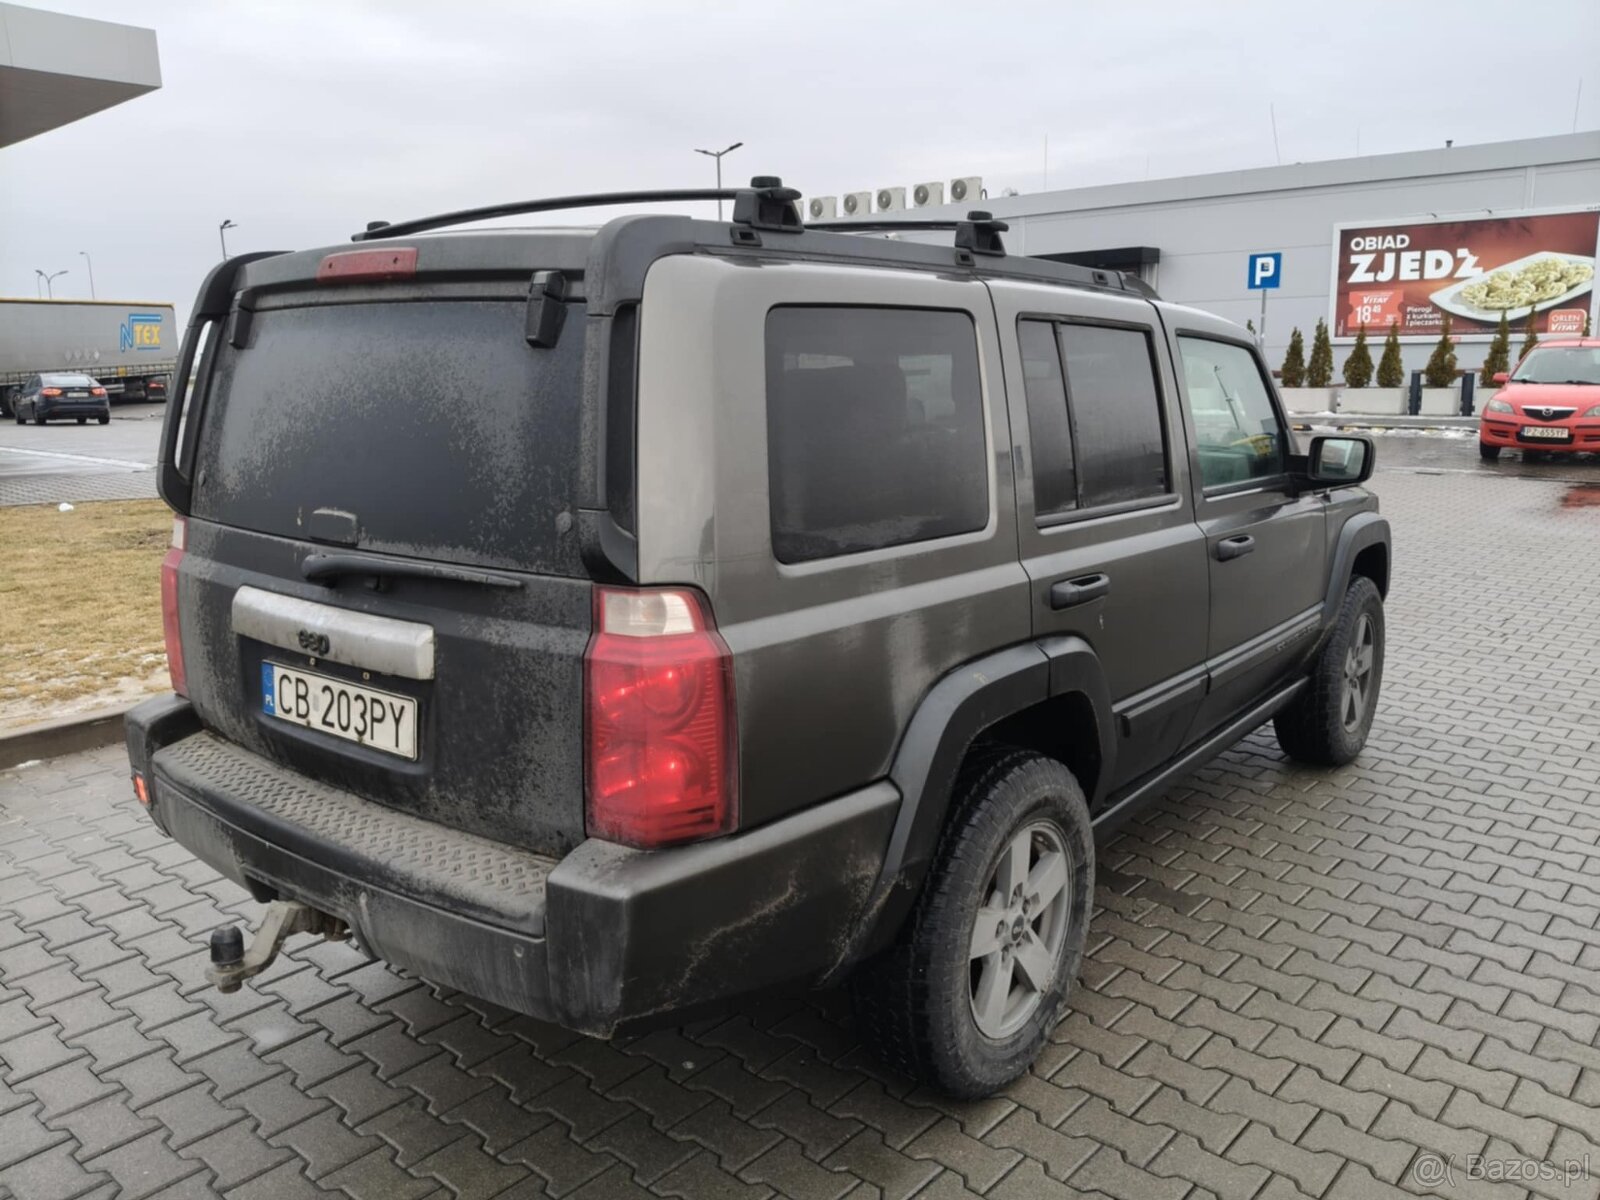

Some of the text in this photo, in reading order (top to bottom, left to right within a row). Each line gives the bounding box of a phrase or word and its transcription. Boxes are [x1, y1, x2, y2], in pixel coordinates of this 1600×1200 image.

[1350, 234, 1410, 251] OBIAD
[1255, 256, 1275, 286] P
[1355, 305, 1372, 323] 18
[1407, 305, 1433, 313] Pierogi
[265, 694, 274, 706] PL
[278, 674, 405, 748] CB 203PY
